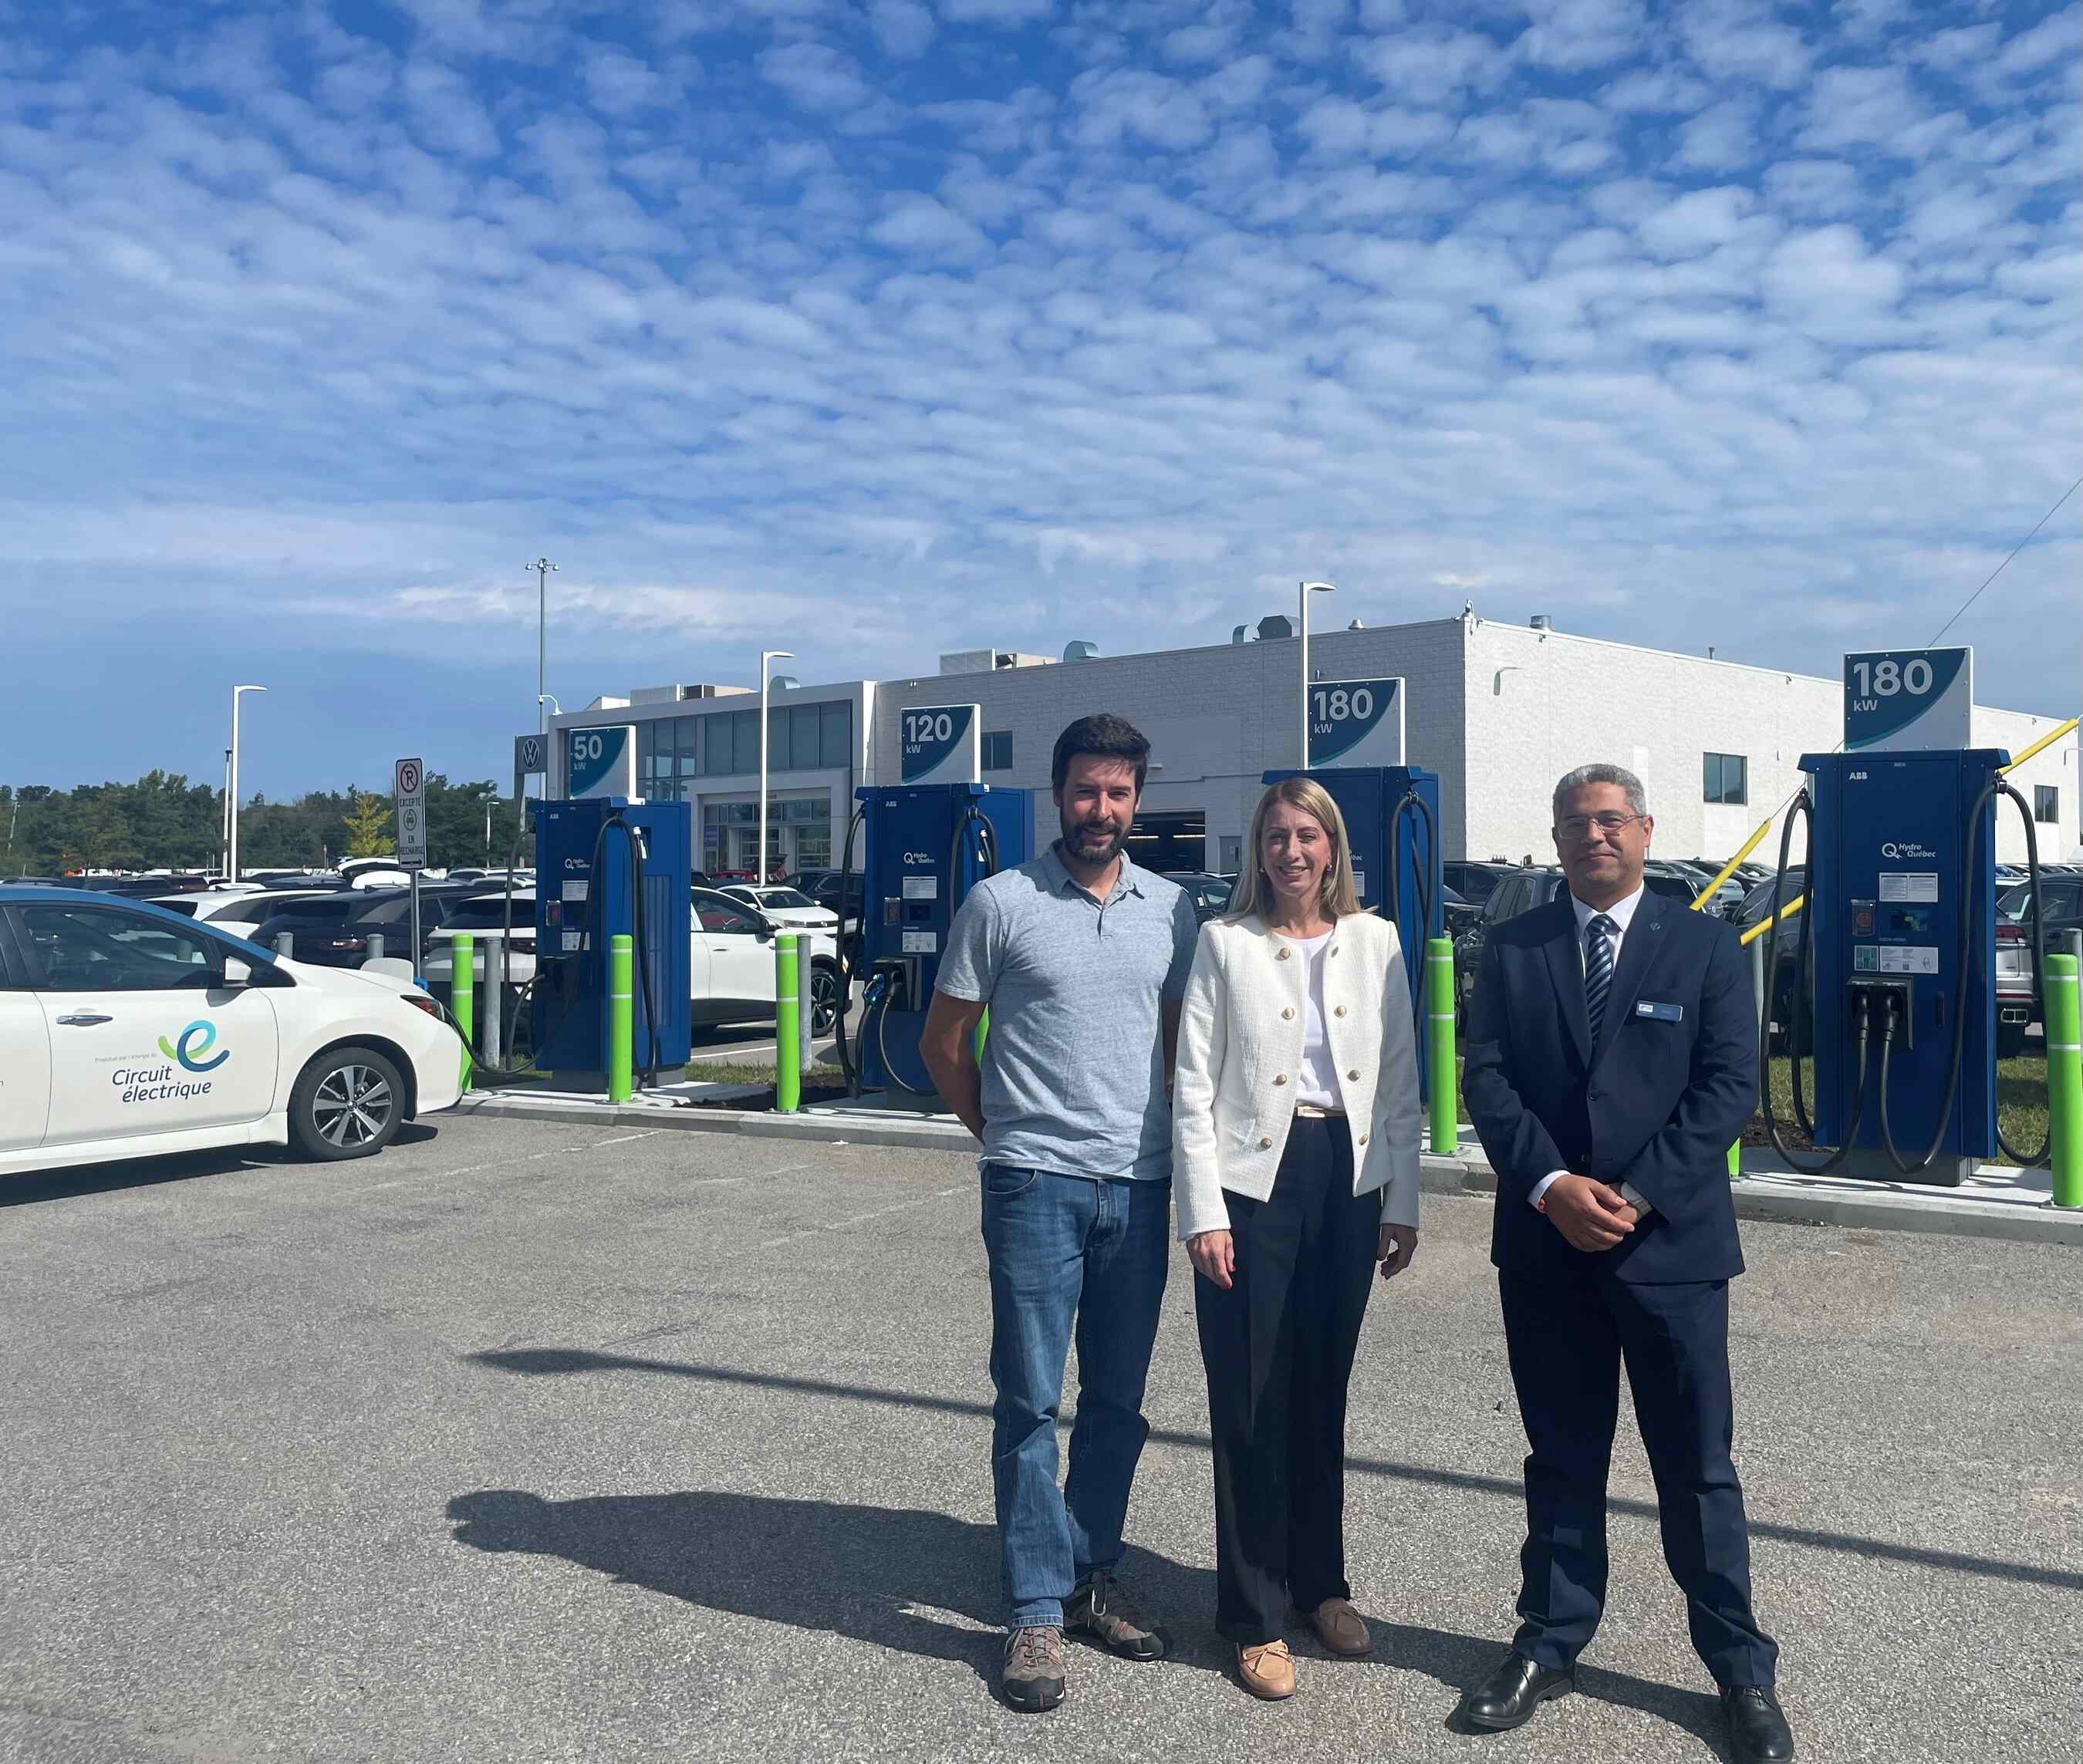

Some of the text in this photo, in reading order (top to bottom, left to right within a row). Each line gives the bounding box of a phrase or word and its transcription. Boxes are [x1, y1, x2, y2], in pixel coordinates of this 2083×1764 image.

[1853, 659, 1933, 696] 180
[1314, 688, 1373, 720] 180
[1853, 700, 1878, 711] kW
[906, 713, 952, 742] 120
[1315, 723, 1333, 734] kW
[573, 735, 603, 760] 50
[906, 744, 921, 754] kW
[574, 761, 587, 771] kW
[1848, 772, 1868, 781] ABB
[1899, 843, 1922, 852] Hydro
[112, 1065, 172, 1085] Circuit
[122, 1081, 211, 1103] électrique
